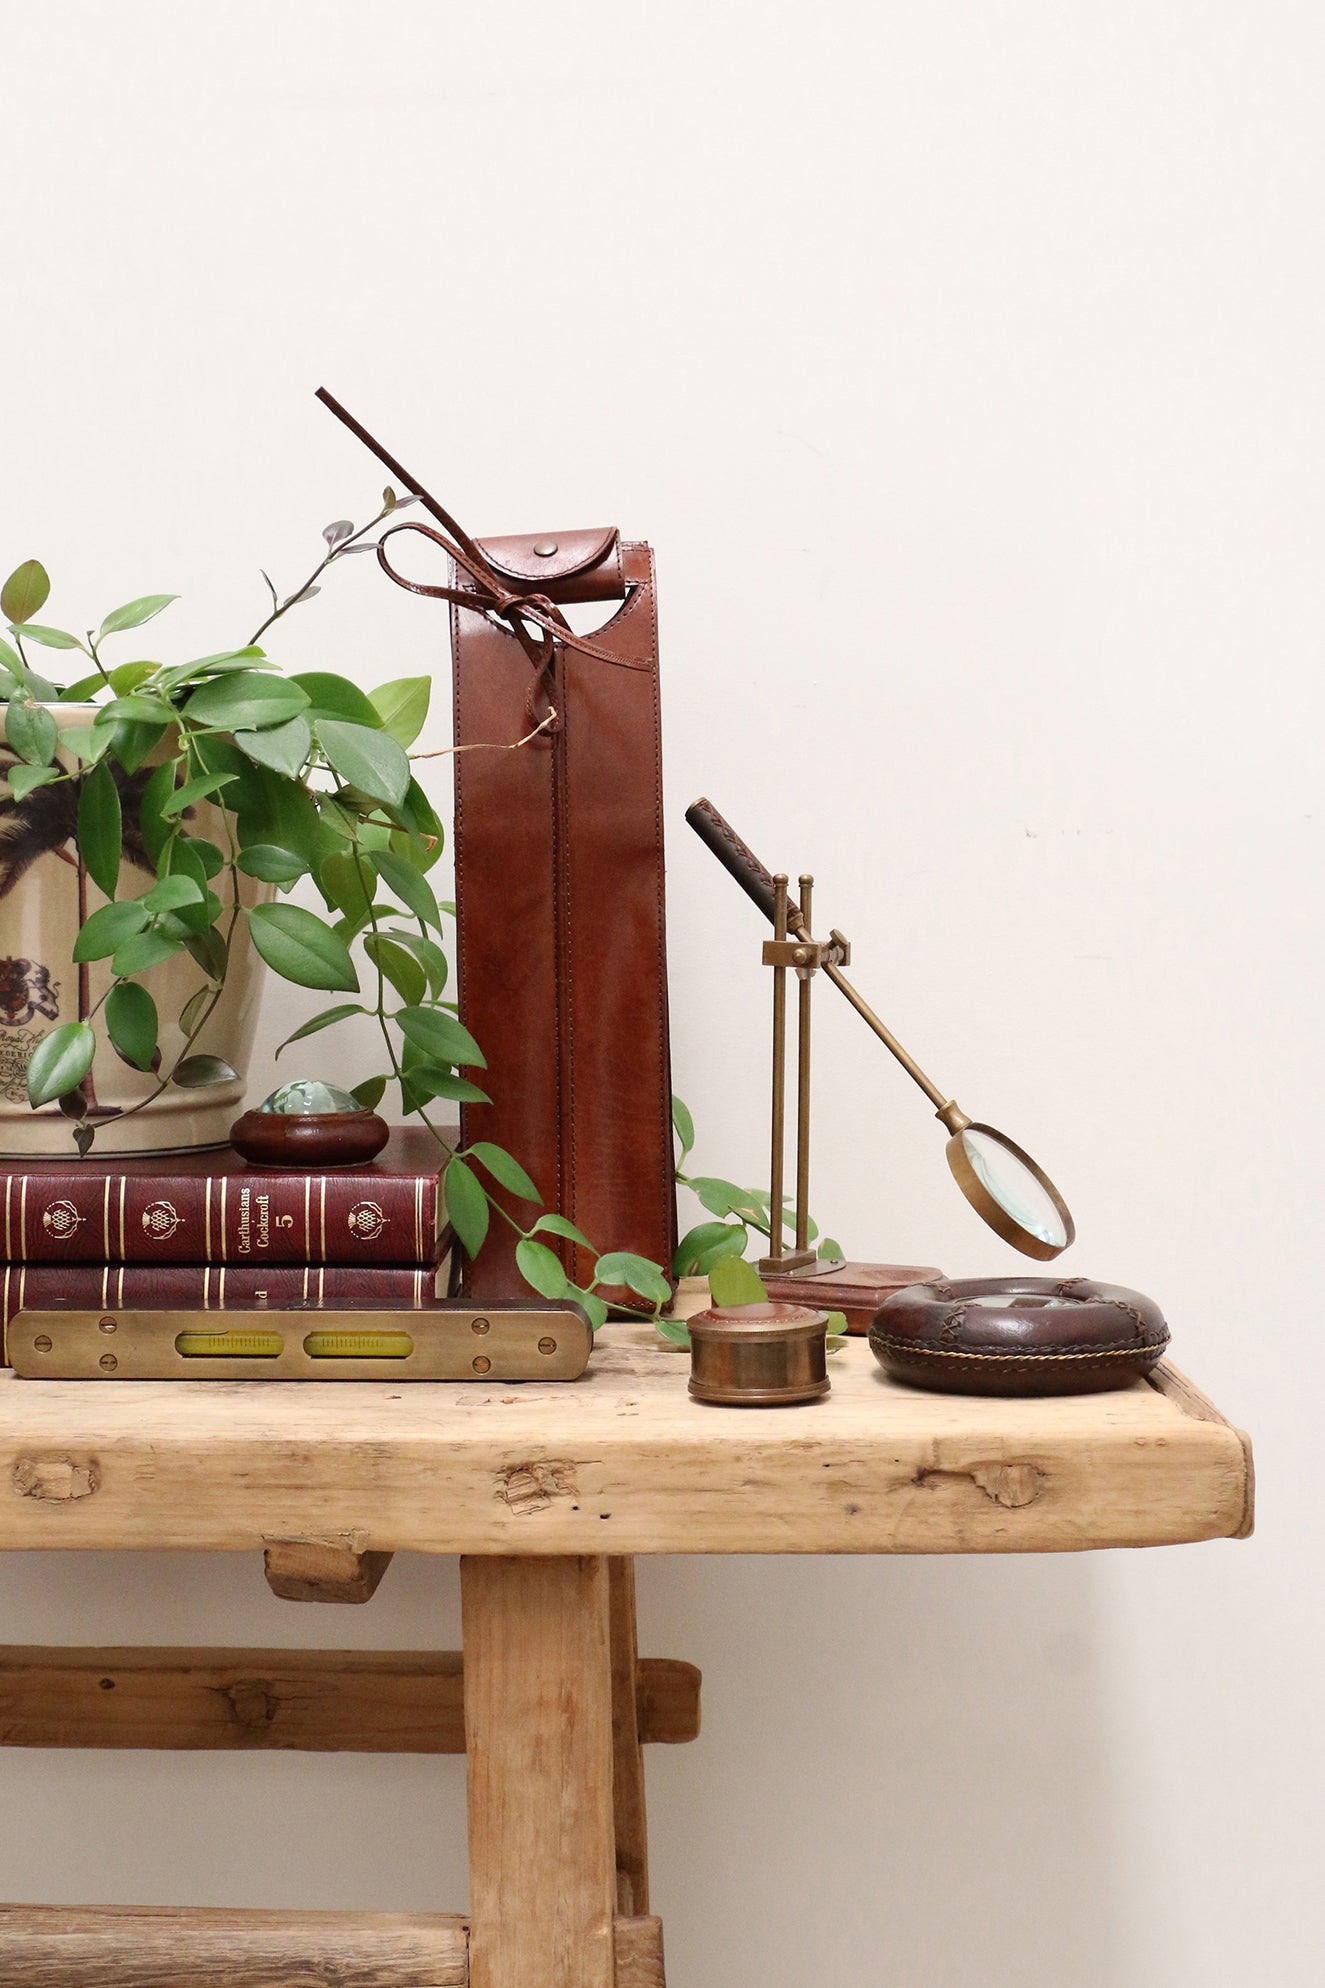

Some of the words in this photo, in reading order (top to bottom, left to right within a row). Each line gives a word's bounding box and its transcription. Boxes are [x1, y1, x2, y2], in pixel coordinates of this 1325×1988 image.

[237, 1187, 251, 1254] Carthusians
[255, 1194, 269, 1248] Cockcroft
[275, 1214, 294, 1229] 5
